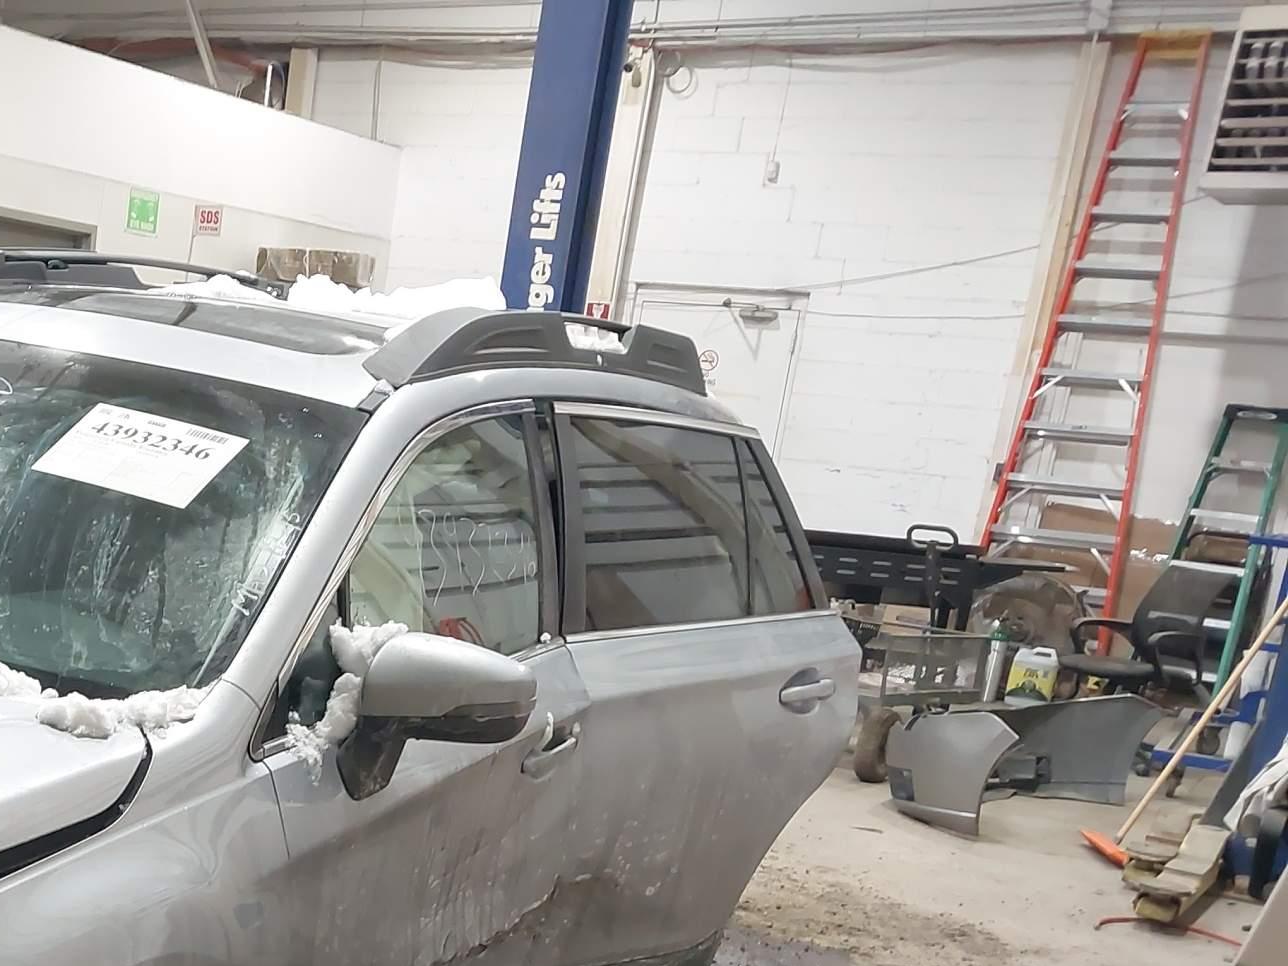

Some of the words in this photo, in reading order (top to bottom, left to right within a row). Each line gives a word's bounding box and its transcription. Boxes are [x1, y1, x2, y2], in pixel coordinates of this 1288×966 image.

[199, 209, 220, 225] SDS
[530, 172, 566, 241] Lifts
[526, 247, 555, 312] ger
[91, 421, 216, 461] 43932346
